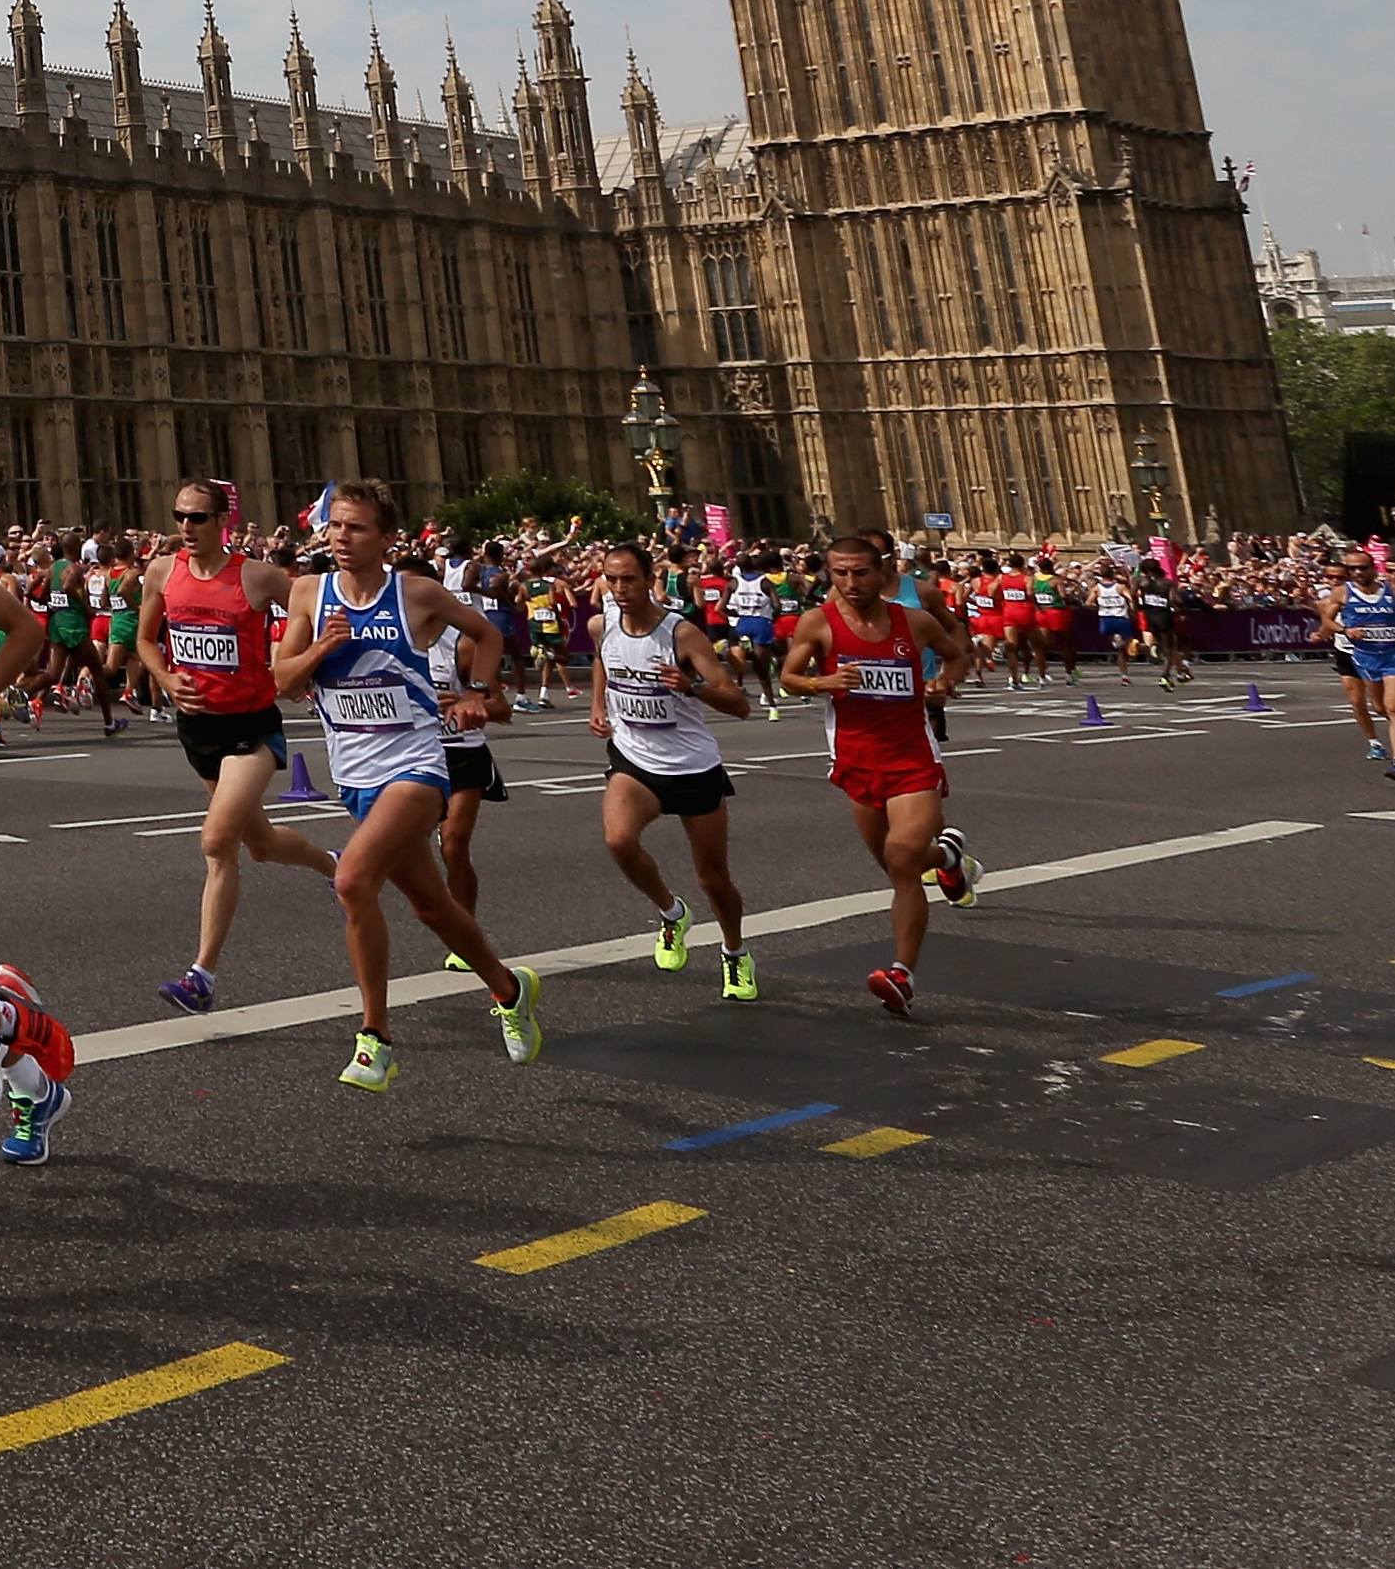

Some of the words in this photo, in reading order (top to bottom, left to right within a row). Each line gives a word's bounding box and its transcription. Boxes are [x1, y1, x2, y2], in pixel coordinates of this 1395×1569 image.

[350, 626, 399, 640] LAND
[1251, 615, 1302, 645] London
[172, 634, 235, 661] TSCHOPP
[337, 679, 363, 687] London
[336, 692, 397, 720] UTRIAINEN
